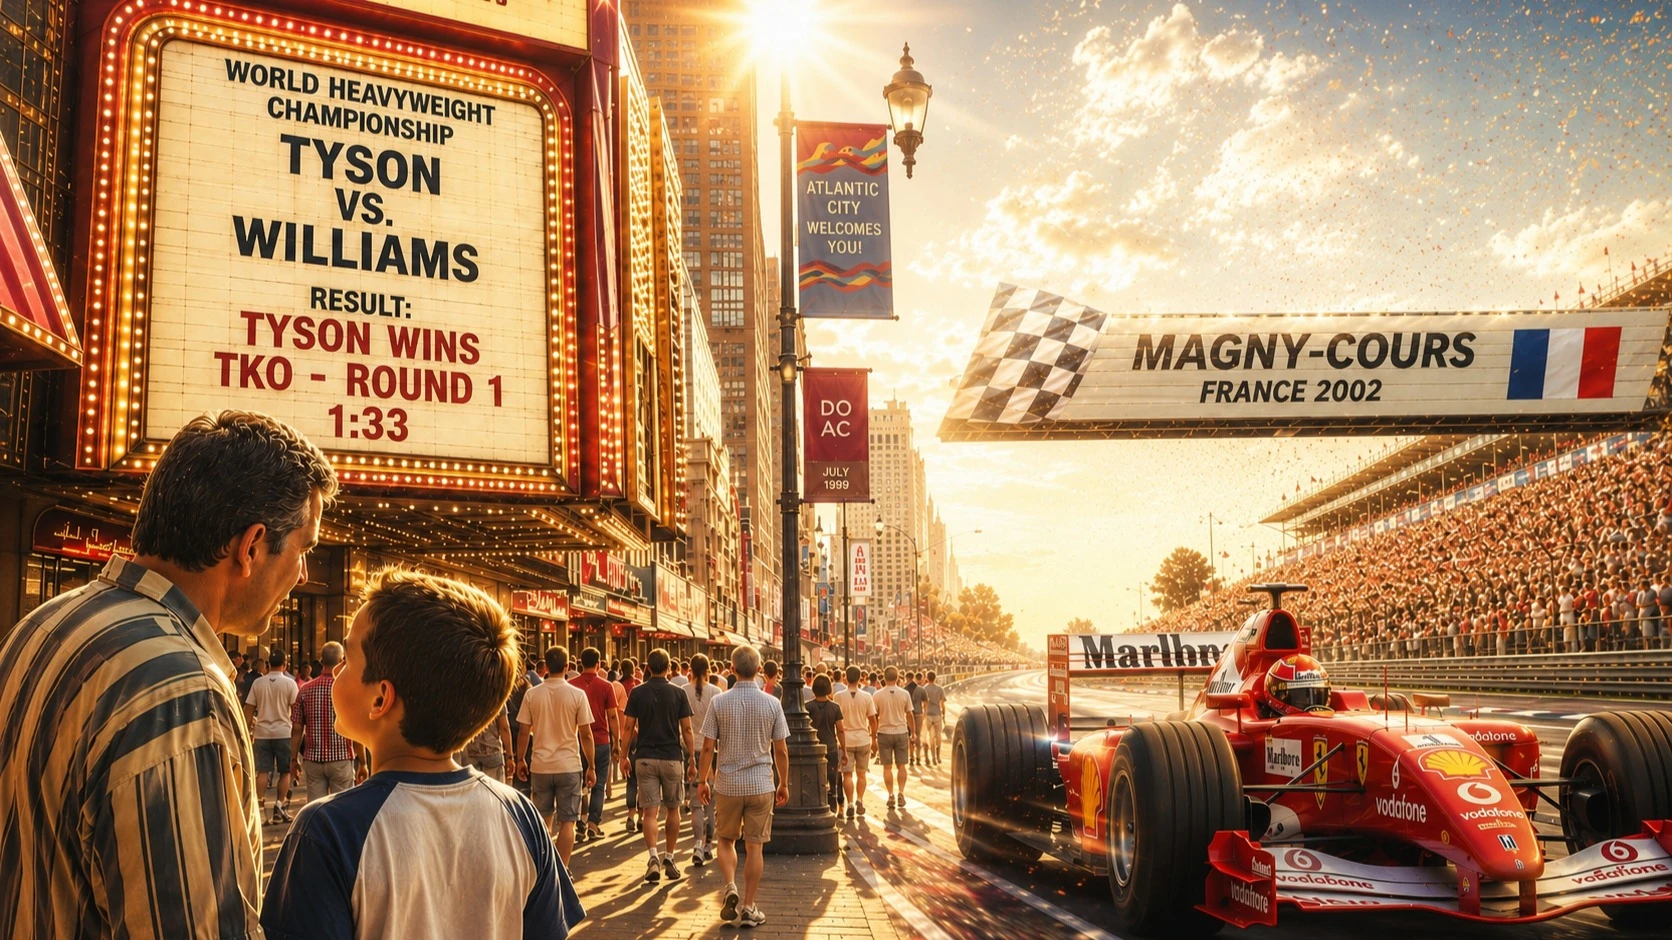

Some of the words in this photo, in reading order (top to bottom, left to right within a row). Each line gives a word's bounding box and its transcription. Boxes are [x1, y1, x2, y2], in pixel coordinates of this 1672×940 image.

[225, 59, 320, 95] WORLD
[329, 77, 496, 126] HEAVYWEIGHT
[267, 97, 454, 145] CHAMPIONSHIP
[280, 133, 441, 196] TYSON
[806, 180, 879, 197] ATLANTIC
[335, 188, 393, 227] VS.
[827, 200, 861, 215] CITY
[806, 221, 882, 236] WELCOMES
[232, 215, 479, 283] WILLIAMS
[827, 240, 862, 254] YOU!
[310, 287, 411, 319] RESULT:
[240, 311, 370, 355] TYSON
[387, 326, 480, 365] WINS
[1132, 331, 1477, 371] MAGNY-COURS
[214, 352, 293, 391] TKO
[311, 373, 325, 382] -
[347, 362, 473, 405] ROUND
[488, 375, 502, 407] 1
[1199, 379, 1308, 404] FRANCE
[1313, 378, 1383, 403] 2002
[328, 405, 408, 442] 1:33
[821, 399, 852, 417] DO
[820, 420, 851, 437] AC
[822, 467, 850, 478] JULY
[823, 480, 850, 490] 1999
[1079, 634, 1230, 669] Marlbn
[1375, 793, 1427, 824] vodafone
